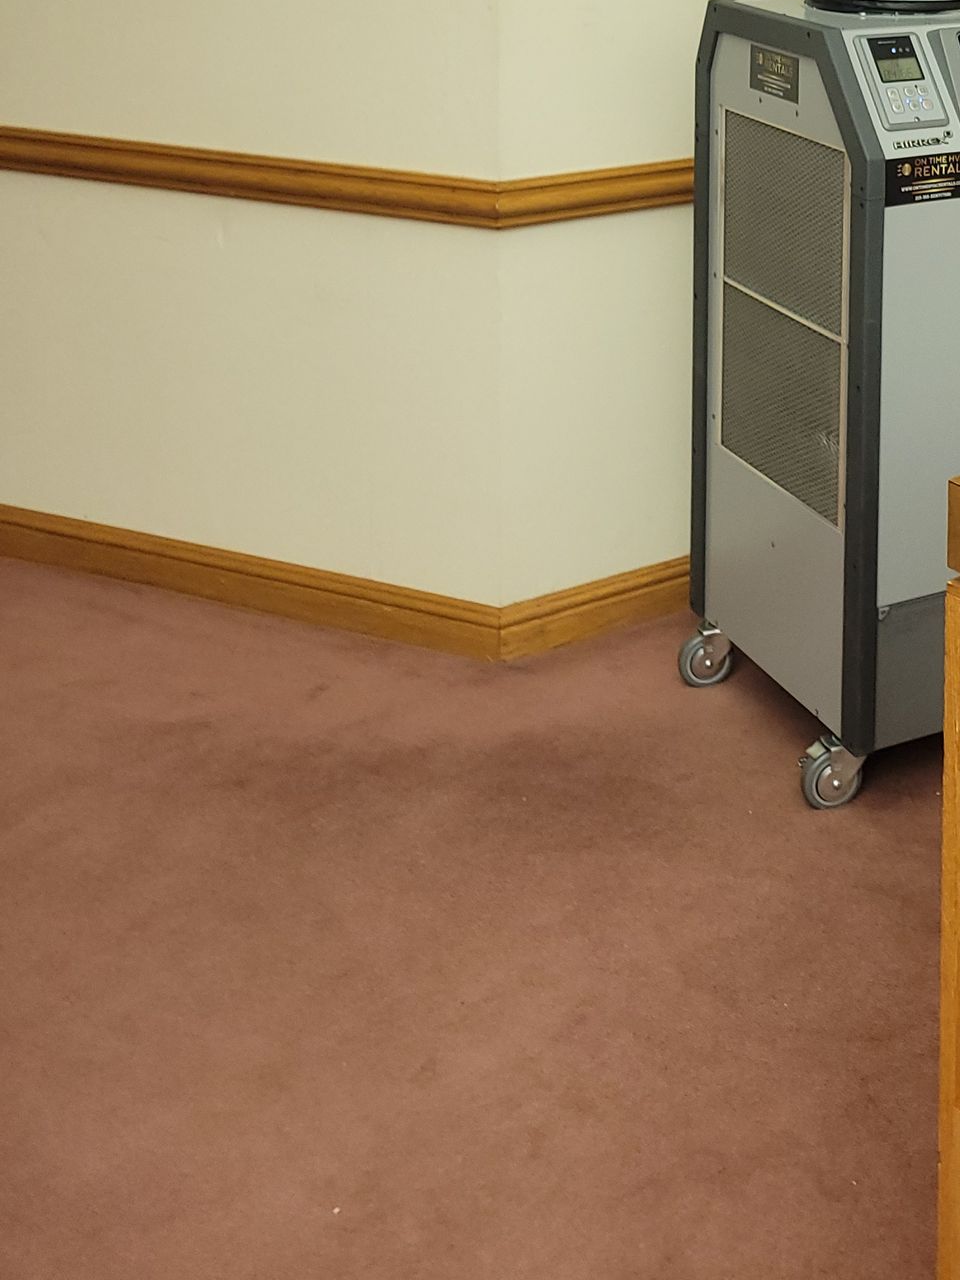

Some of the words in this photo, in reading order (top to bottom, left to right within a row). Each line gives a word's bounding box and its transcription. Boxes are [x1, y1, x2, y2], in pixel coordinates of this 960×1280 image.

[893, 134, 951, 150] AIRREX
[914, 158, 928, 167] ON
[929, 155, 947, 166] TIME
